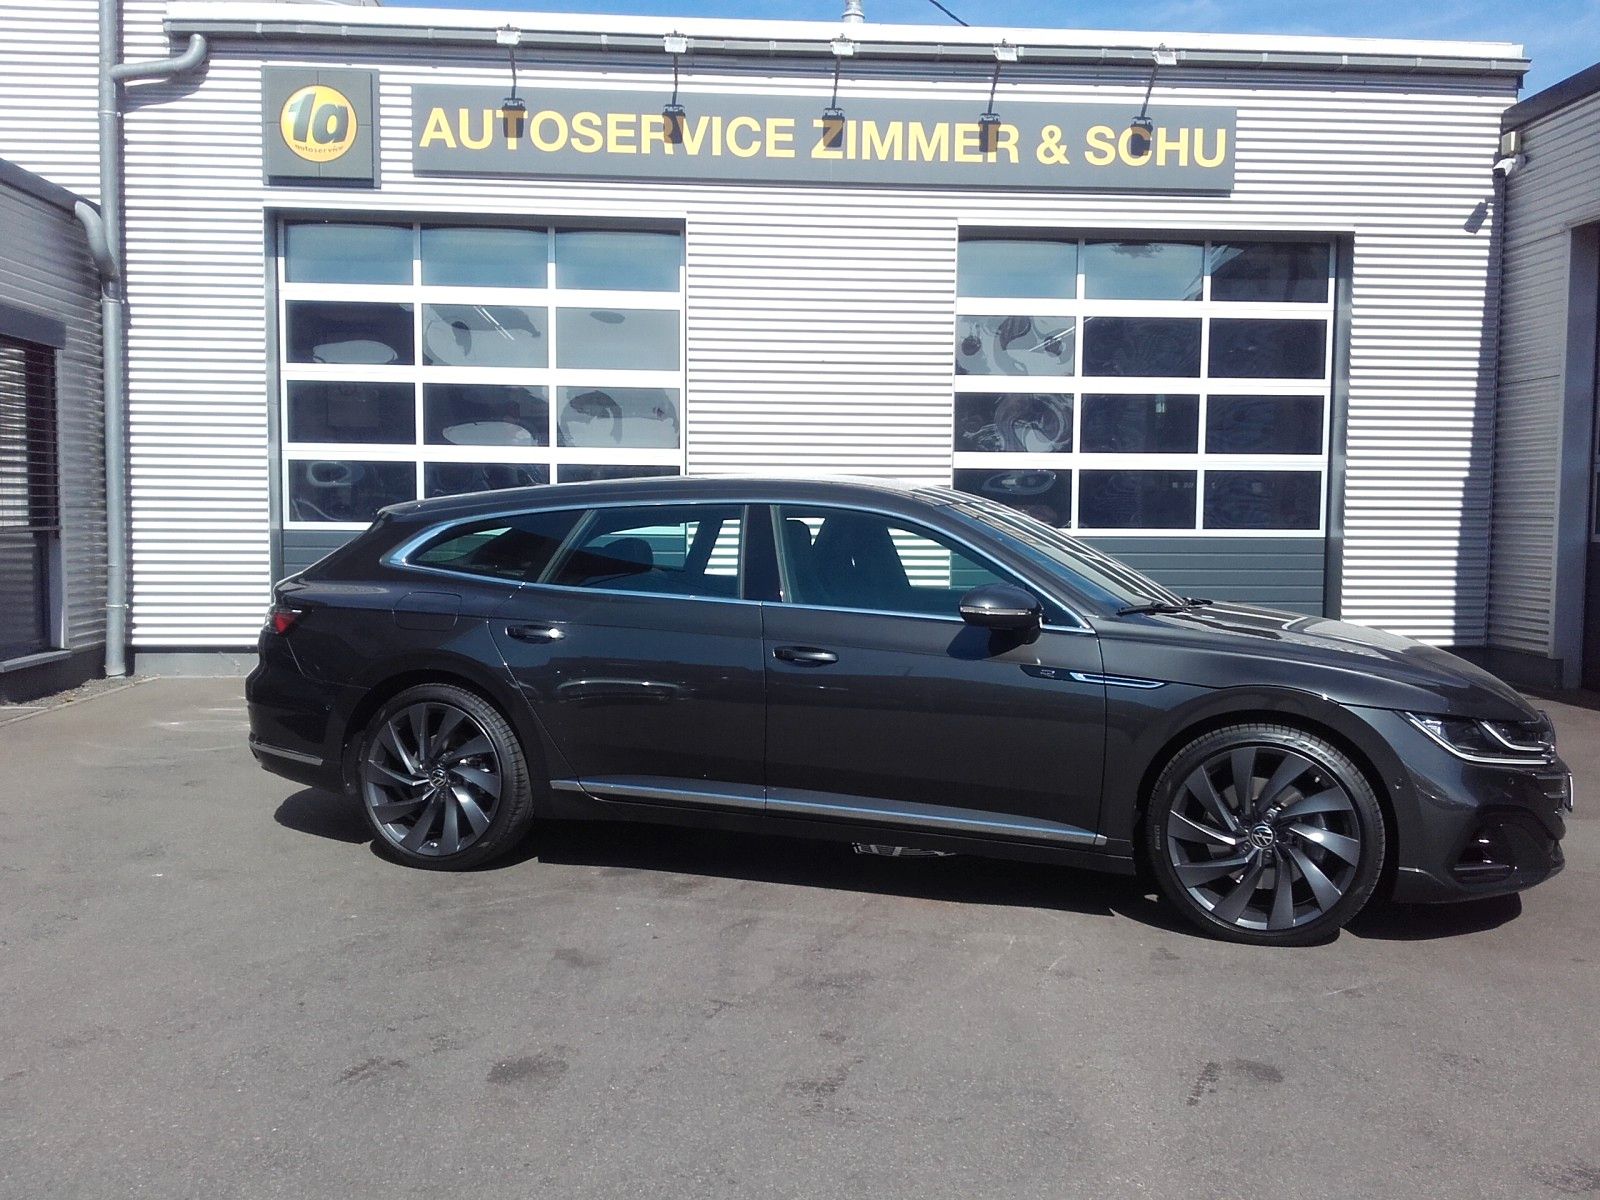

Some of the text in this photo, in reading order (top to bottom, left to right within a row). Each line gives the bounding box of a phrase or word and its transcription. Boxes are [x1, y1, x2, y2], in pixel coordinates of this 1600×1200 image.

[288, 92, 349, 145] 1a
[419, 107, 1227, 168] AUTOSERVICE ZIMMER & SCHU
